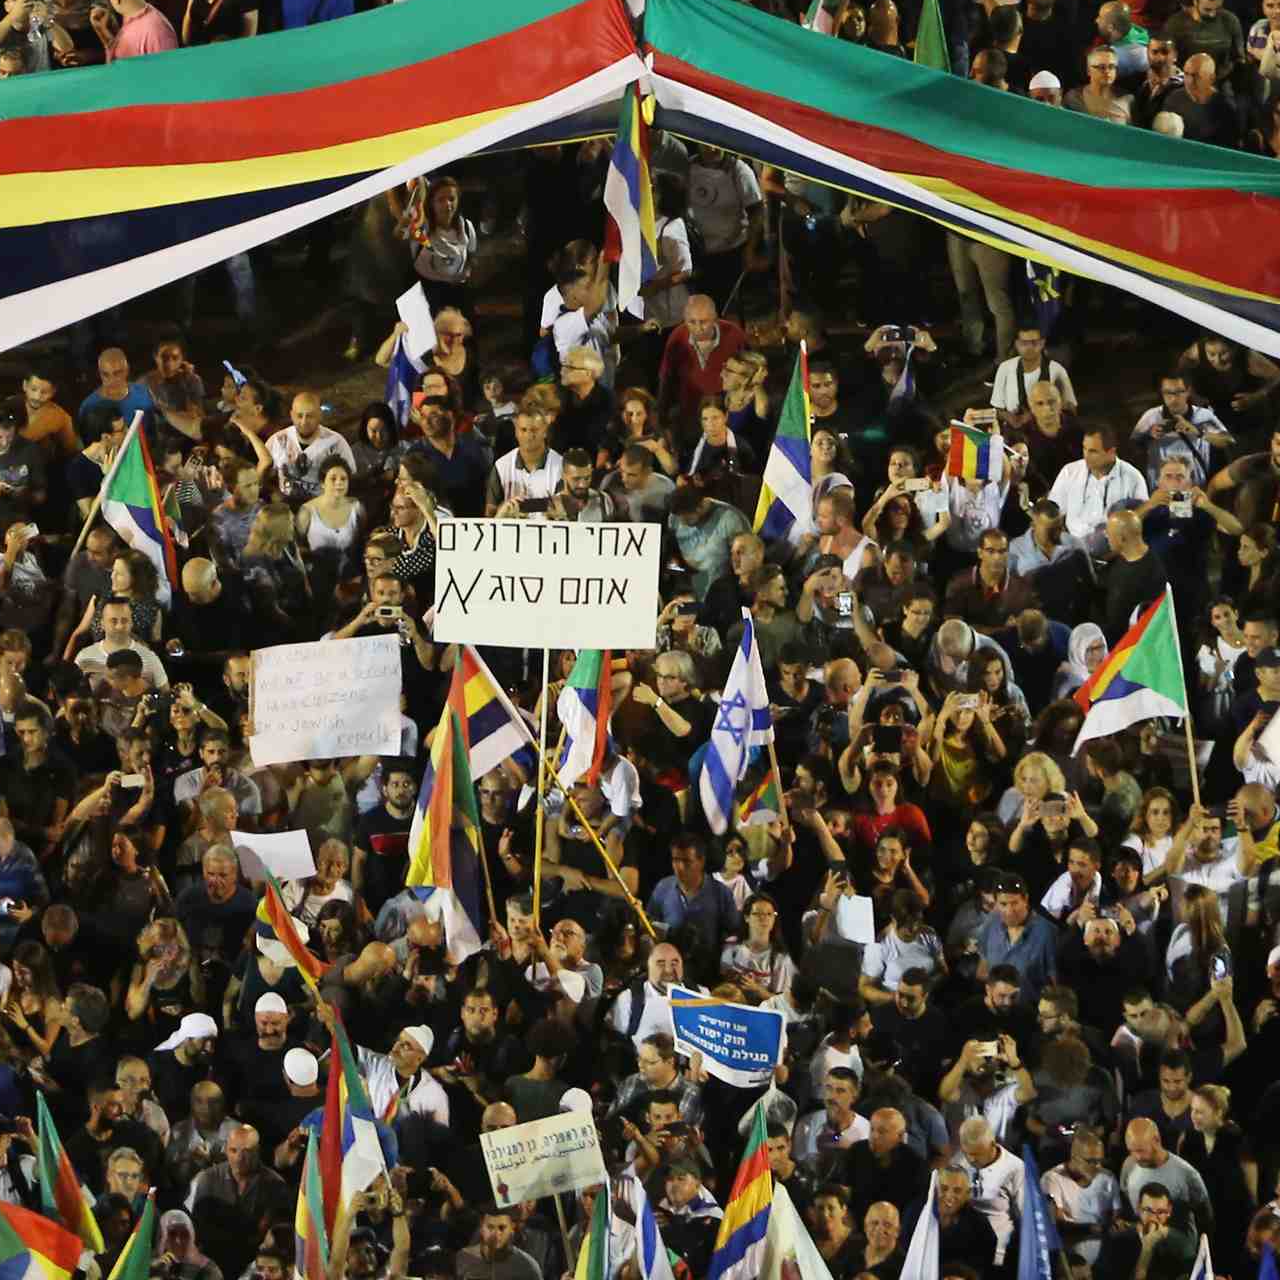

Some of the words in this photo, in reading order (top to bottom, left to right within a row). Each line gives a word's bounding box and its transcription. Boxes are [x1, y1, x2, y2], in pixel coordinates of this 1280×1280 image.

[438, 522, 570, 555] הדרוזים
[585, 527, 647, 557] אחי
[488, 575, 545, 604] סוג
[559, 577, 629, 605] אתם
[698, 1024, 722, 1039] יסוד
[723, 1033, 746, 1047] חוק
[731, 1049, 769, 1062] מגילת
